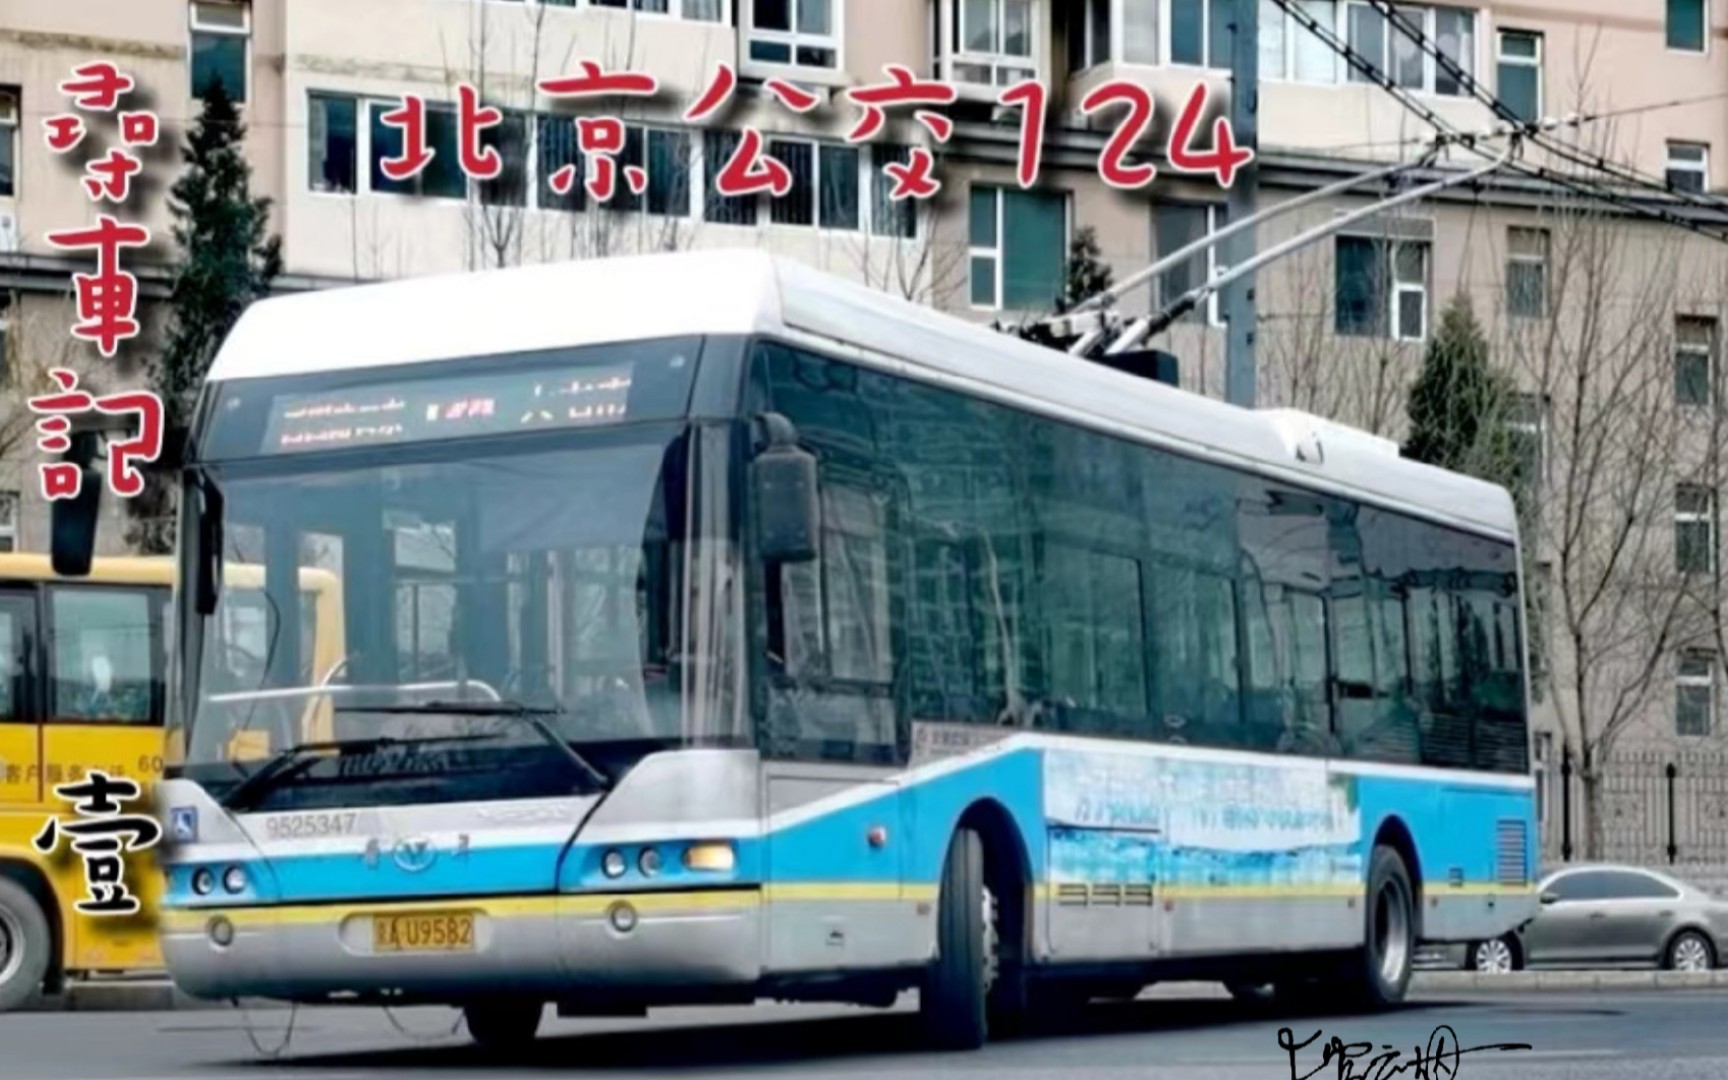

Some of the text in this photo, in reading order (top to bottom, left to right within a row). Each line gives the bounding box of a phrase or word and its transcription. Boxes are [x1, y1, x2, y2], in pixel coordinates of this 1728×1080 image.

[6, 763, 124, 784] 客户服务
[265, 812, 356, 839] 9525347
